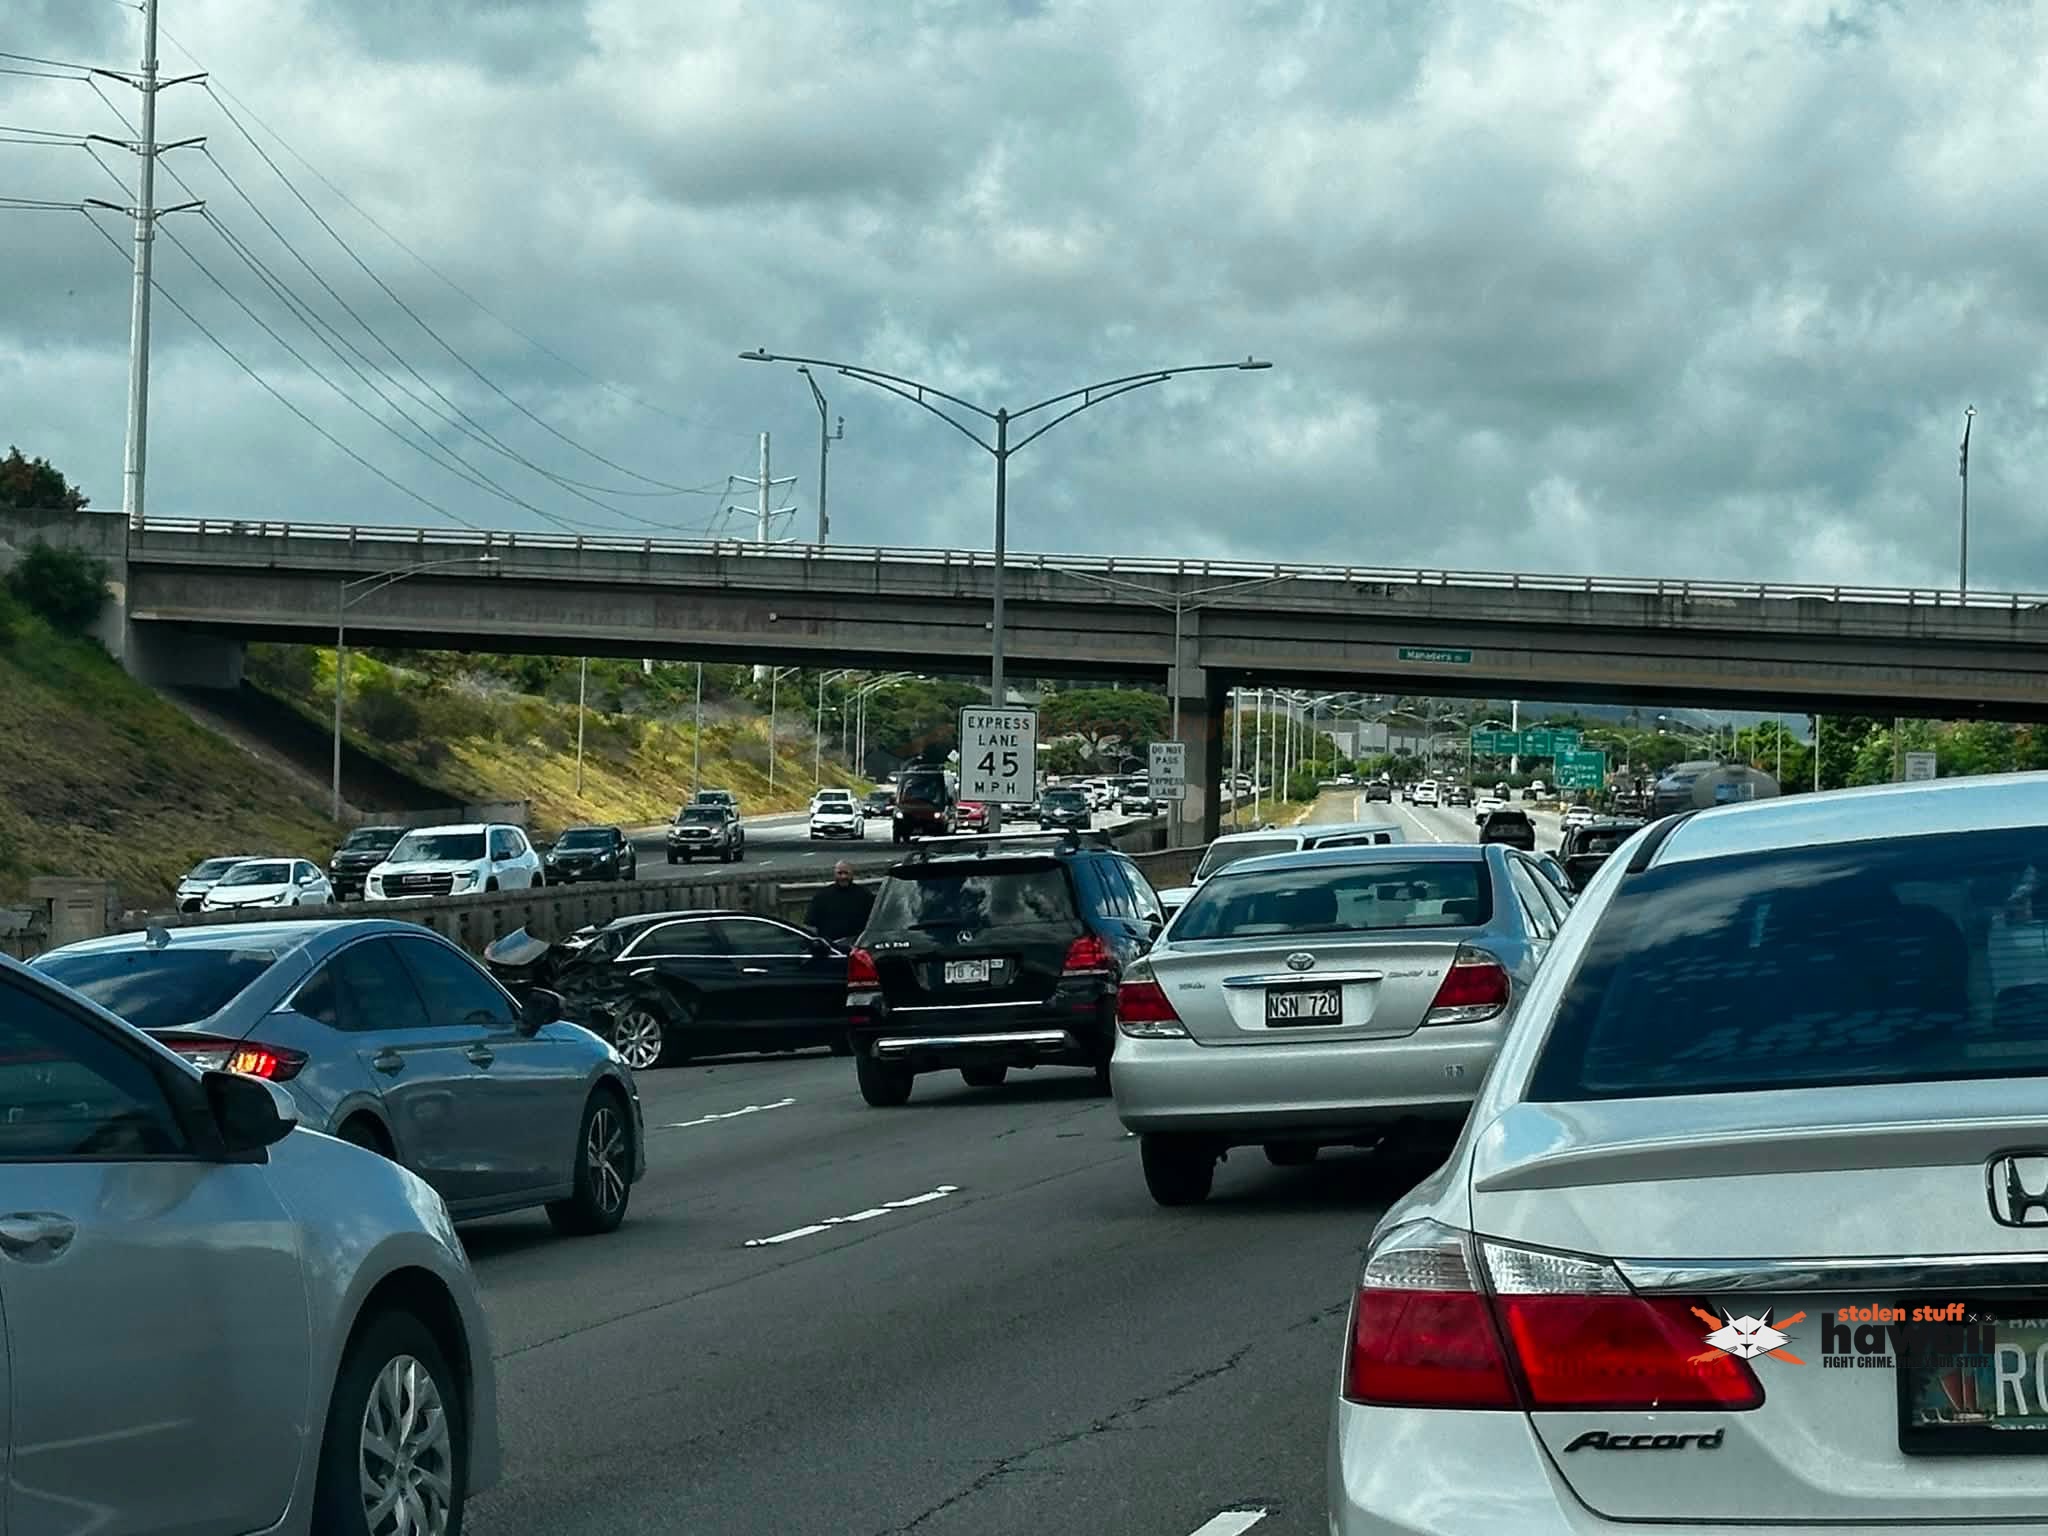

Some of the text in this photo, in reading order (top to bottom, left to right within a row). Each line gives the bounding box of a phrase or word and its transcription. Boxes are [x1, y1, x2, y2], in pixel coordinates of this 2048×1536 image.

[968, 716, 1029, 730] EXPRESS
[978, 734, 1018, 747] LANE
[977, 751, 1019, 777] 45
[1269, 994, 1337, 1017] NSN 720
[1563, 1428, 1725, 1452] Accord
